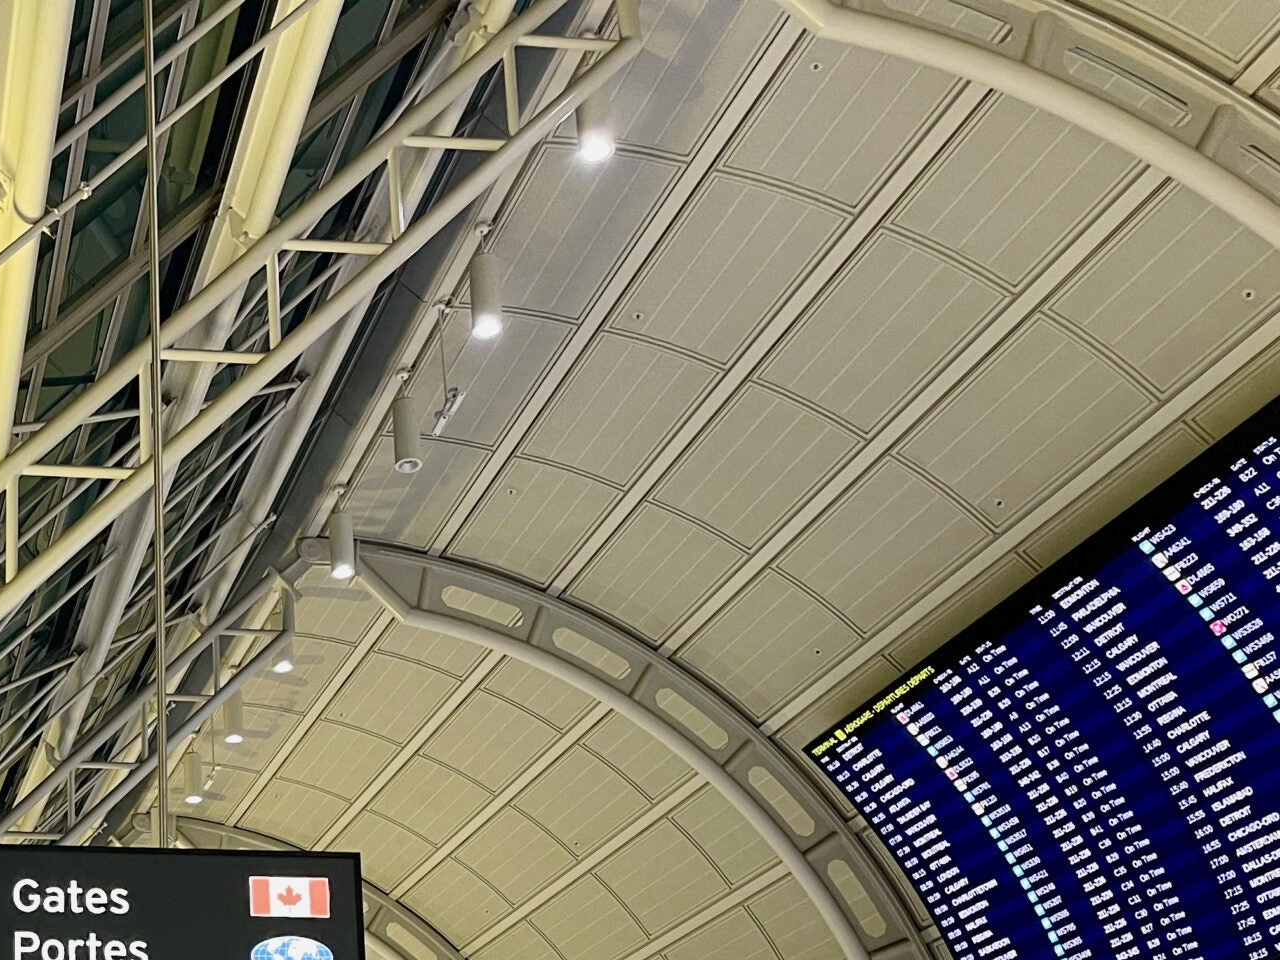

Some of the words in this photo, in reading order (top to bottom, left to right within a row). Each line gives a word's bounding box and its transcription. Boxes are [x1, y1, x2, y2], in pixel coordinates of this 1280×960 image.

[1038, 610, 1056, 624] 11:00
[1060, 579, 1099, 609] EDMONTON
[1150, 524, 1176, 544] WS423
[1239, 467, 1258, 482] B22
[1050, 622, 1068, 637] 11:45
[1072, 587, 1121, 621] PHILADELPHIA
[1163, 537, 1192, 559] AA6241
[1254, 482, 1270, 496] A11
[1061, 634, 1079, 649] 12:00
[1083, 602, 1126, 633] VANCOUVER
[1072, 647, 1090, 661] 12:11
[1094, 622, 1124, 646] DETROIT
[1082, 659, 1101, 674] 12:15
[1106, 634, 1138, 658] CALGARY
[1198, 578, 1225, 598] WS659
[1093, 672, 1112, 686] 12:15
[1116, 641, 1160, 671] VANCOUVER
[1210, 592, 1237, 612] WS711
[1104, 684, 1122, 699] 12:25
[1126, 657, 1168, 685] EDMONTON
[1114, 698, 1132, 712] 13:15
[1137, 672, 1177, 698] MONTREAL
[812, 738, 838, 756] TERMINAL
[872, 684, 910, 712] DEPARTURES
[1124, 712, 1142, 726] 13:30
[1148, 691, 1178, 712] OTTAWA
[1133, 724, 1152, 739] 13:55
[1156, 706, 1186, 726] REGINA
[1143, 738, 1161, 753] 14:40
[1167, 711, 1210, 739] CHARLOTTE
[1152, 752, 1170, 767] 15:00
[1176, 730, 1210, 753] CALGARY
[1161, 767, 1180, 781] 15:00
[1185, 740, 1230, 767] VANCOUVER
[1170, 781, 1188, 795] 15:40
[1194, 751, 1246, 782] FREDERICTON
[1178, 795, 1197, 810] 15:45
[1203, 776, 1234, 797] HALIFAX
[1187, 810, 1205, 824] 15:55
[1211, 786, 1253, 812] ISLAMABAD
[1194, 825, 1213, 839] 16:00
[1219, 805, 1251, 827] DETROIT
[1202, 839, 1221, 854] 16:55
[1228, 812, 1280, 841] CHICAGO-ORD
[1210, 855, 1229, 869] 17:00
[1217, 870, 1236, 884] 17:00
[12, 879, 130, 914] Gates
[1224, 885, 1243, 899] 17:15
[1231, 901, 1250, 914] 17:25
[1237, 916, 1256, 930] 17:45
[1244, 932, 1262, 946] 18:15
